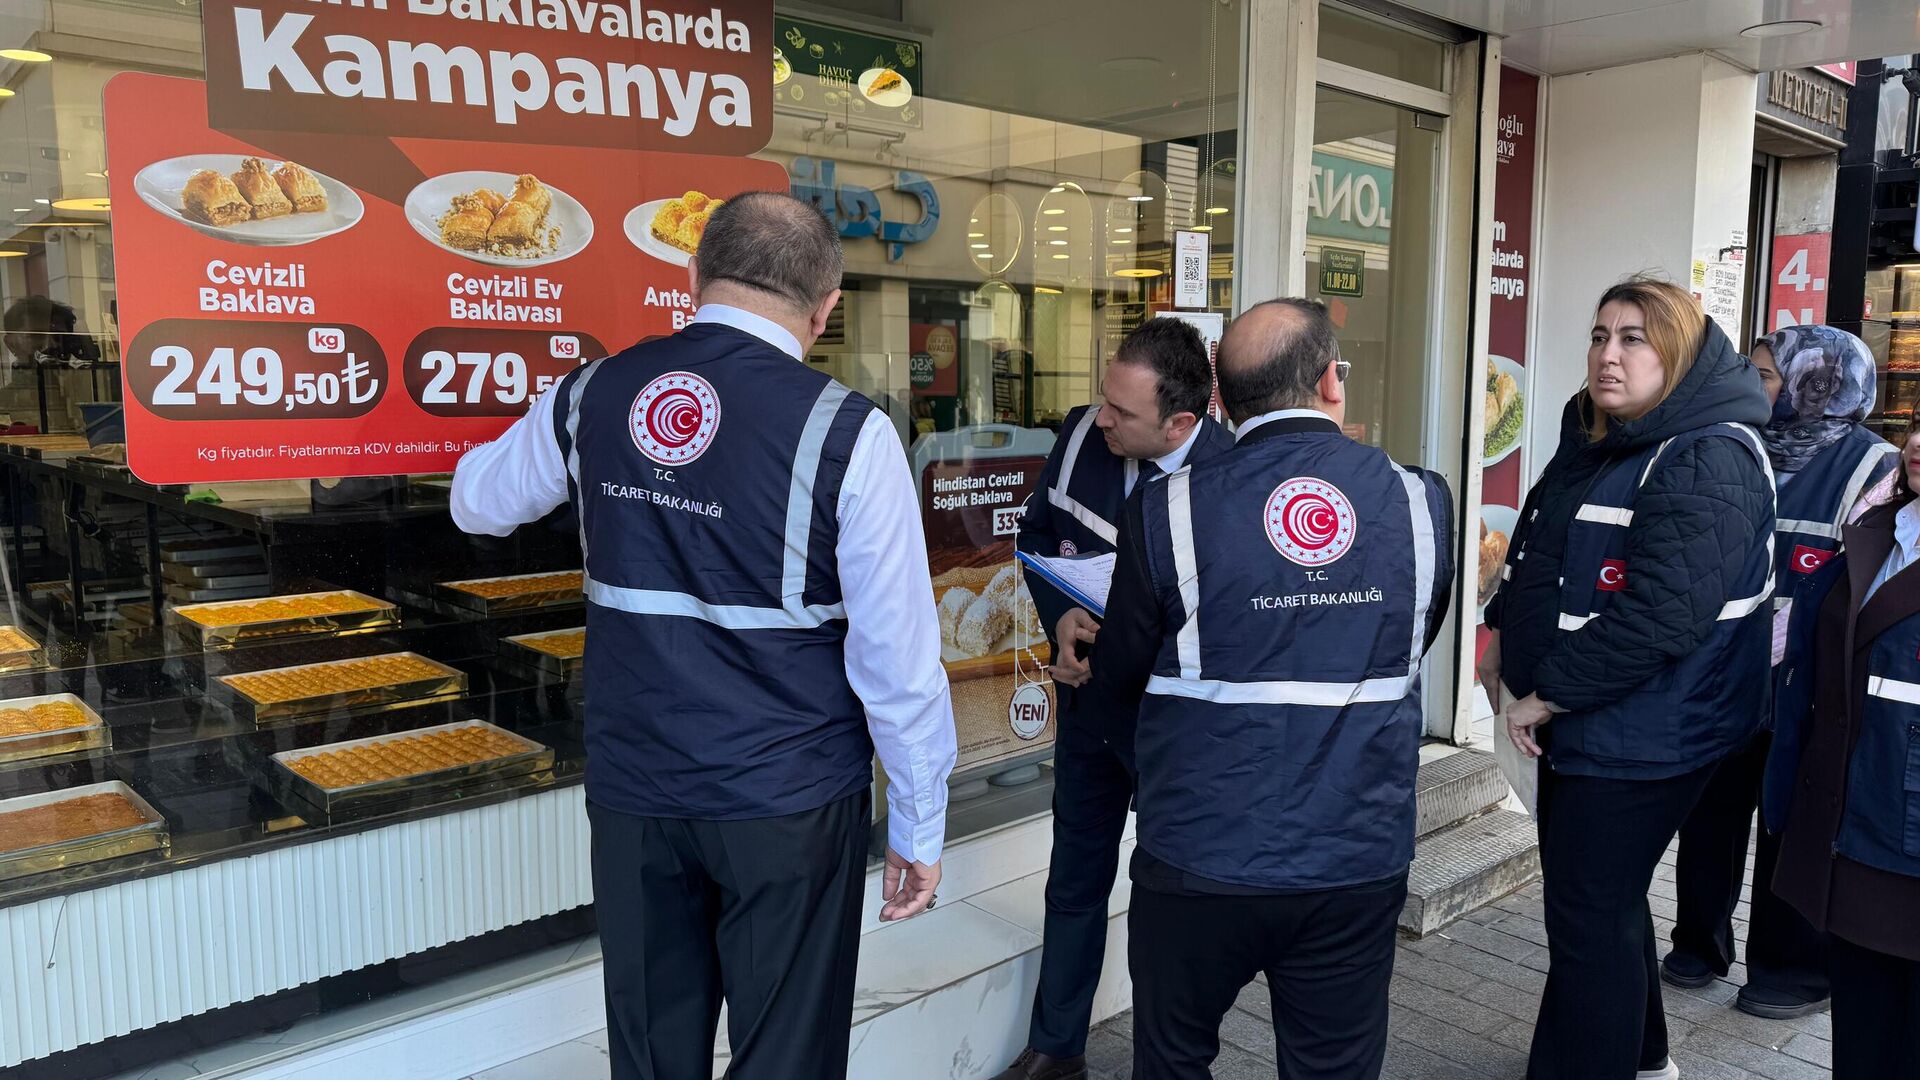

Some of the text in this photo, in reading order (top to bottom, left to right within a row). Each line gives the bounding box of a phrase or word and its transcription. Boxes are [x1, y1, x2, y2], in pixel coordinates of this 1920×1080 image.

[234, 7, 752, 137] Kampanya
[206, 259, 306, 288] Cevizli
[1778, 249, 1825, 291] 4.
[447, 272, 563, 300] Cevizli Ev
[199, 287, 316, 315] Baklava
[450, 298, 562, 323] Baklavası
[314, 331, 339, 349] kg
[555, 338, 575, 355] kg
[198, 448, 217, 461] Kg
[221, 446, 275, 460] fiyatıdır.
[279, 445, 361, 459] Fiyatlarımıza
[364, 443, 391, 454] KDV
[395, 441, 441, 453] dahildir.
[445, 441, 460, 452] Bu
[653, 468, 676, 482] T.C.
[933, 472, 1024, 492] Hindistan Cevizli
[601, 482, 722, 518] TİCARET BAKANLIĞI
[933, 490, 1013, 510] Soğuk Baklava
[1305, 570, 1329, 582] T.C.
[1251, 587, 1383, 610] TİCARET BAKANLIĞI
[1013, 699, 1045, 721] YENİ
